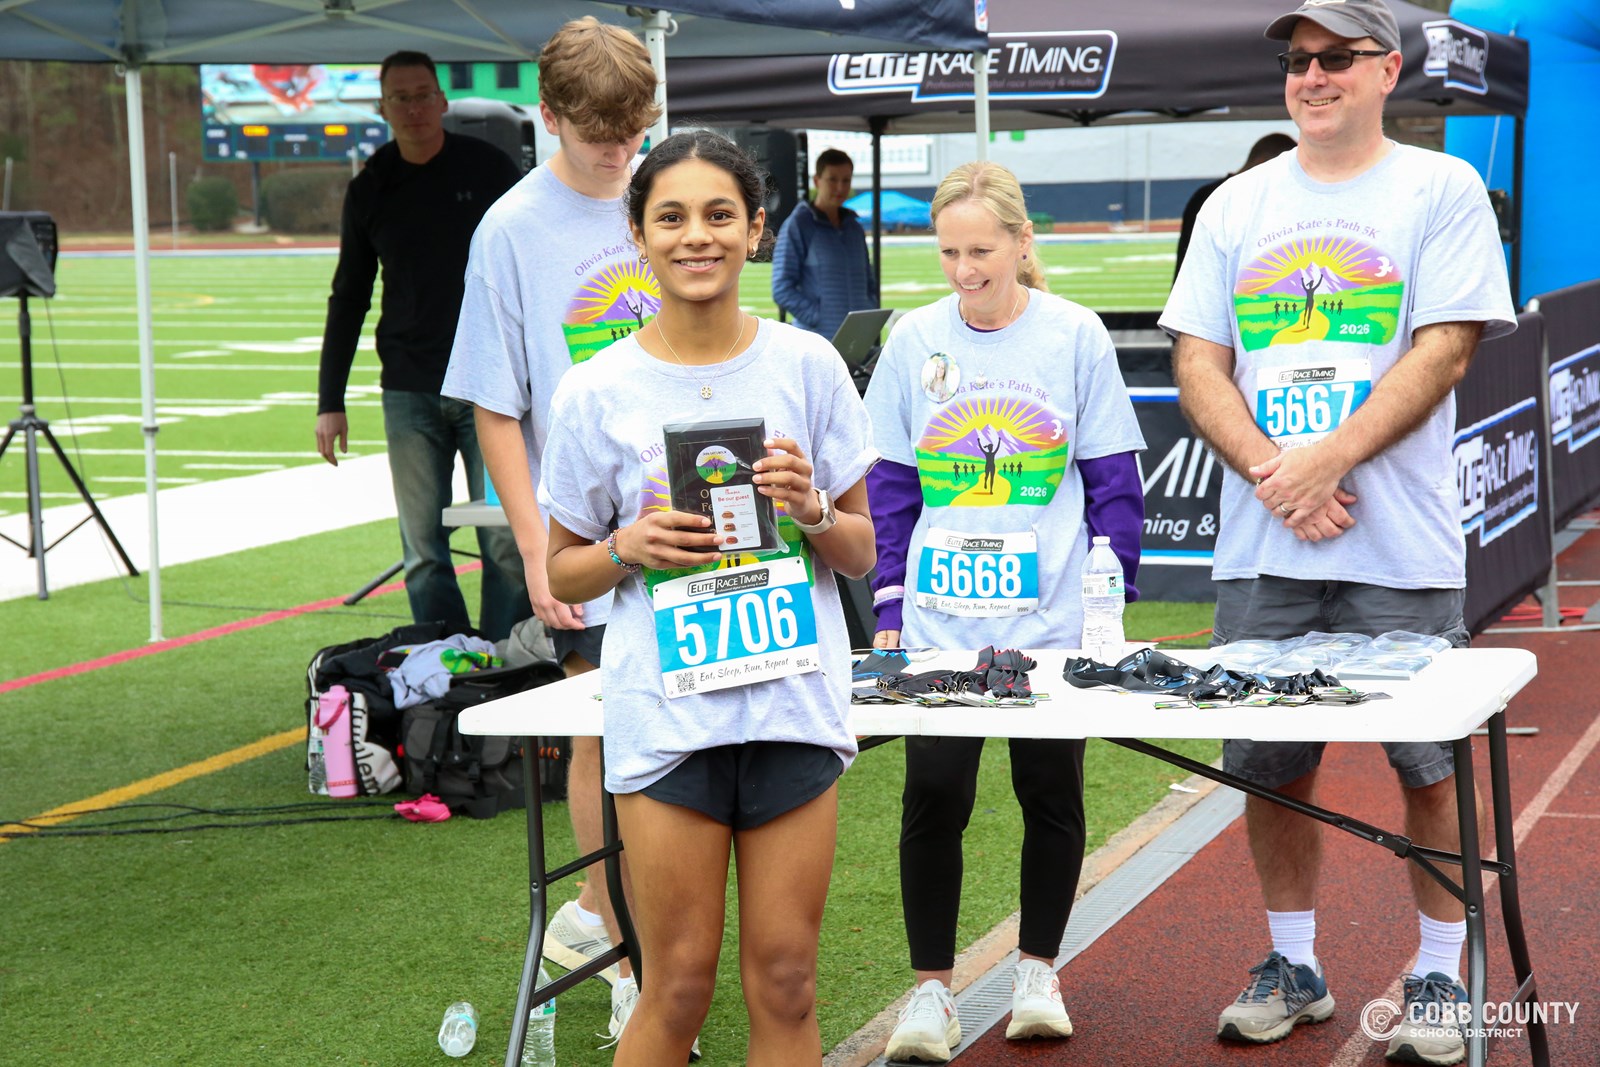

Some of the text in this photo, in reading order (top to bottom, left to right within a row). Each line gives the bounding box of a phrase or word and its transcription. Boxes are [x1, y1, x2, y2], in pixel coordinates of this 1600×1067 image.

[844, 53, 921, 79] ELITE
[1006, 42, 1099, 74] TIMING
[1257, 226, 1293, 248] Olivia
[1335, 219, 1361, 232] Path
[1362, 226, 1380, 239] 5K
[574, 254, 603, 276] Olivia
[1339, 324, 1370, 335] 2026
[1293, 370, 1311, 380] RACE
[1311, 368, 1335, 378] TIMING
[1008, 380, 1033, 393] Path
[1034, 388, 1051, 402] 5K
[1266, 382, 1355, 437] 5667
[1484, 443, 1507, 494] RACE
[735, 494, 750, 502] guest
[1020, 485, 1048, 498] 2026
[1196, 513, 1216, 536] &
[947, 537, 1003, 549] ELITE RACE TIMING
[690, 572, 767, 594] ELITE RACE TIMING
[930, 550, 1022, 598] 5668
[989, 603, 1011, 611] Repeat
[673, 588, 798, 666] 5706
[700, 658, 789, 682] Eat, Sleep, Run, Repeat
